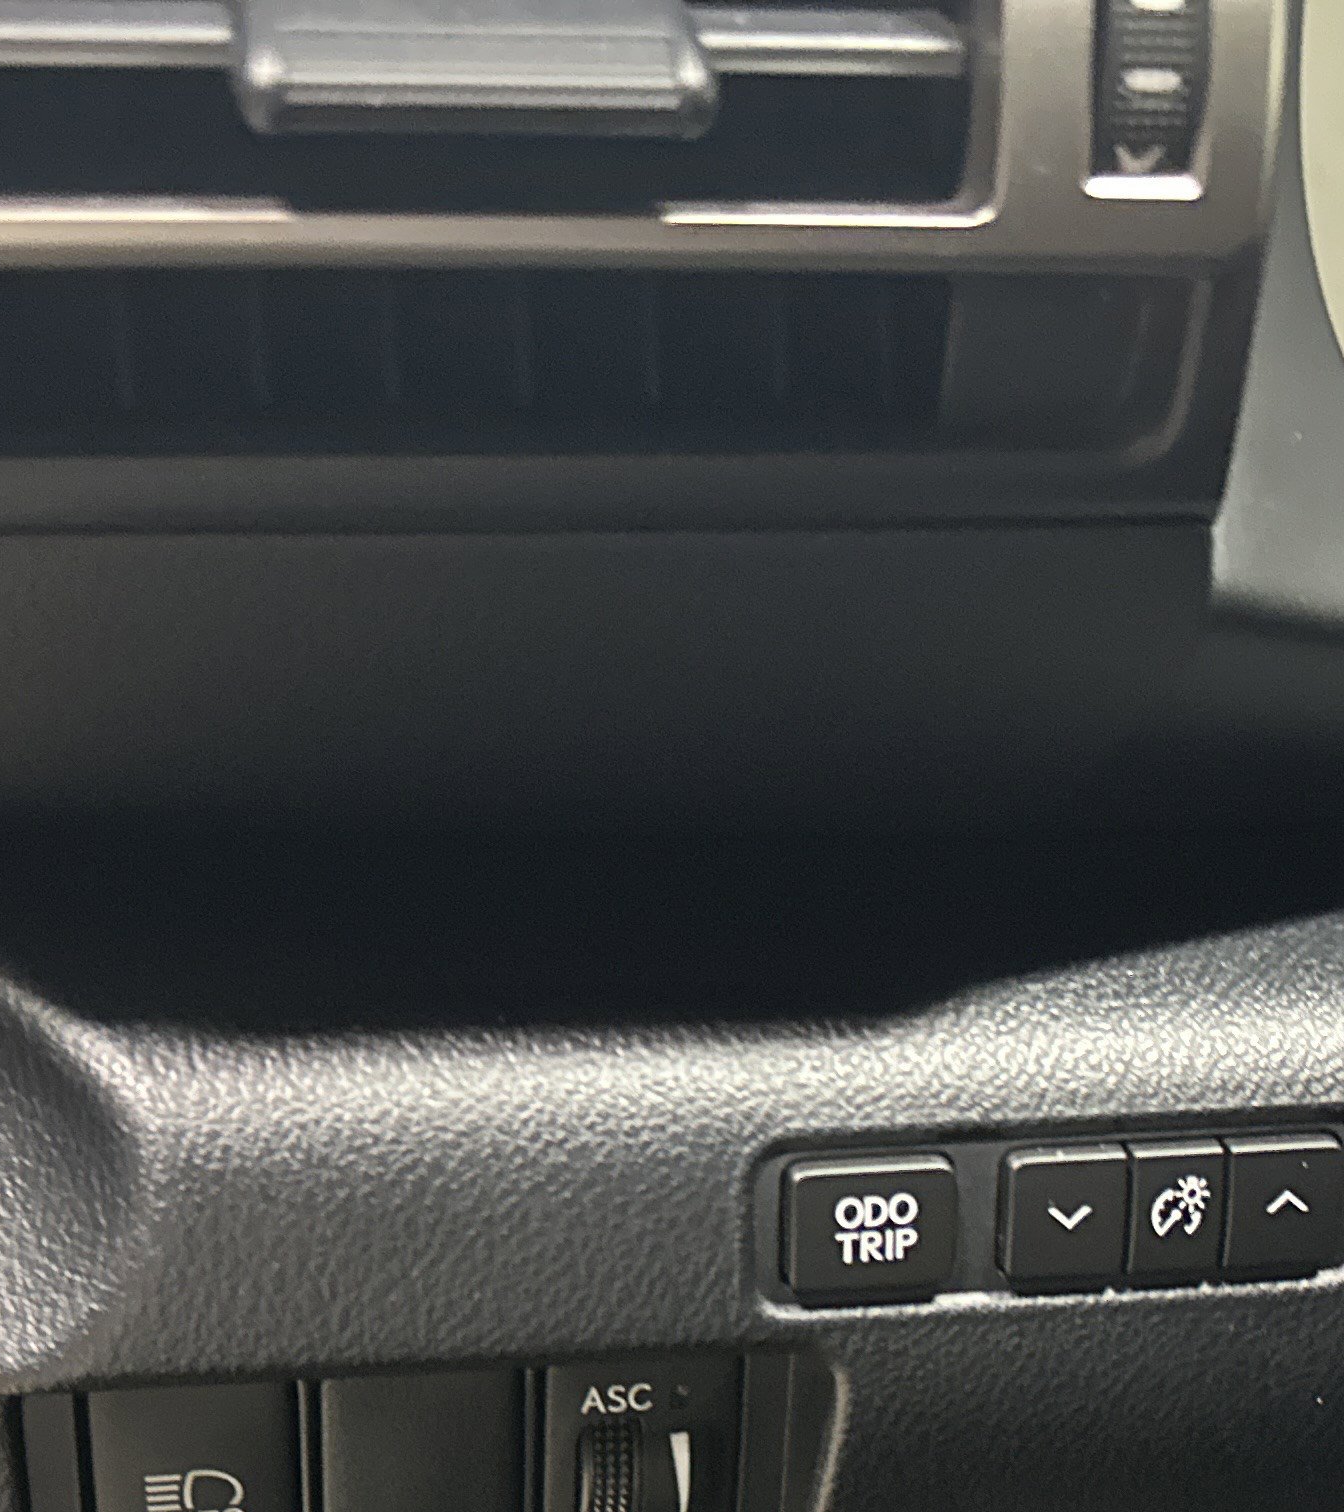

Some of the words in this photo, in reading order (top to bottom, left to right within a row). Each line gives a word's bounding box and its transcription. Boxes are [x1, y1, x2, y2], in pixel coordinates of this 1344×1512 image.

[835, 1192, 918, 1230] ODO
[834, 1227, 918, 1264] TRIP
[579, 1382, 654, 1415] ASC
